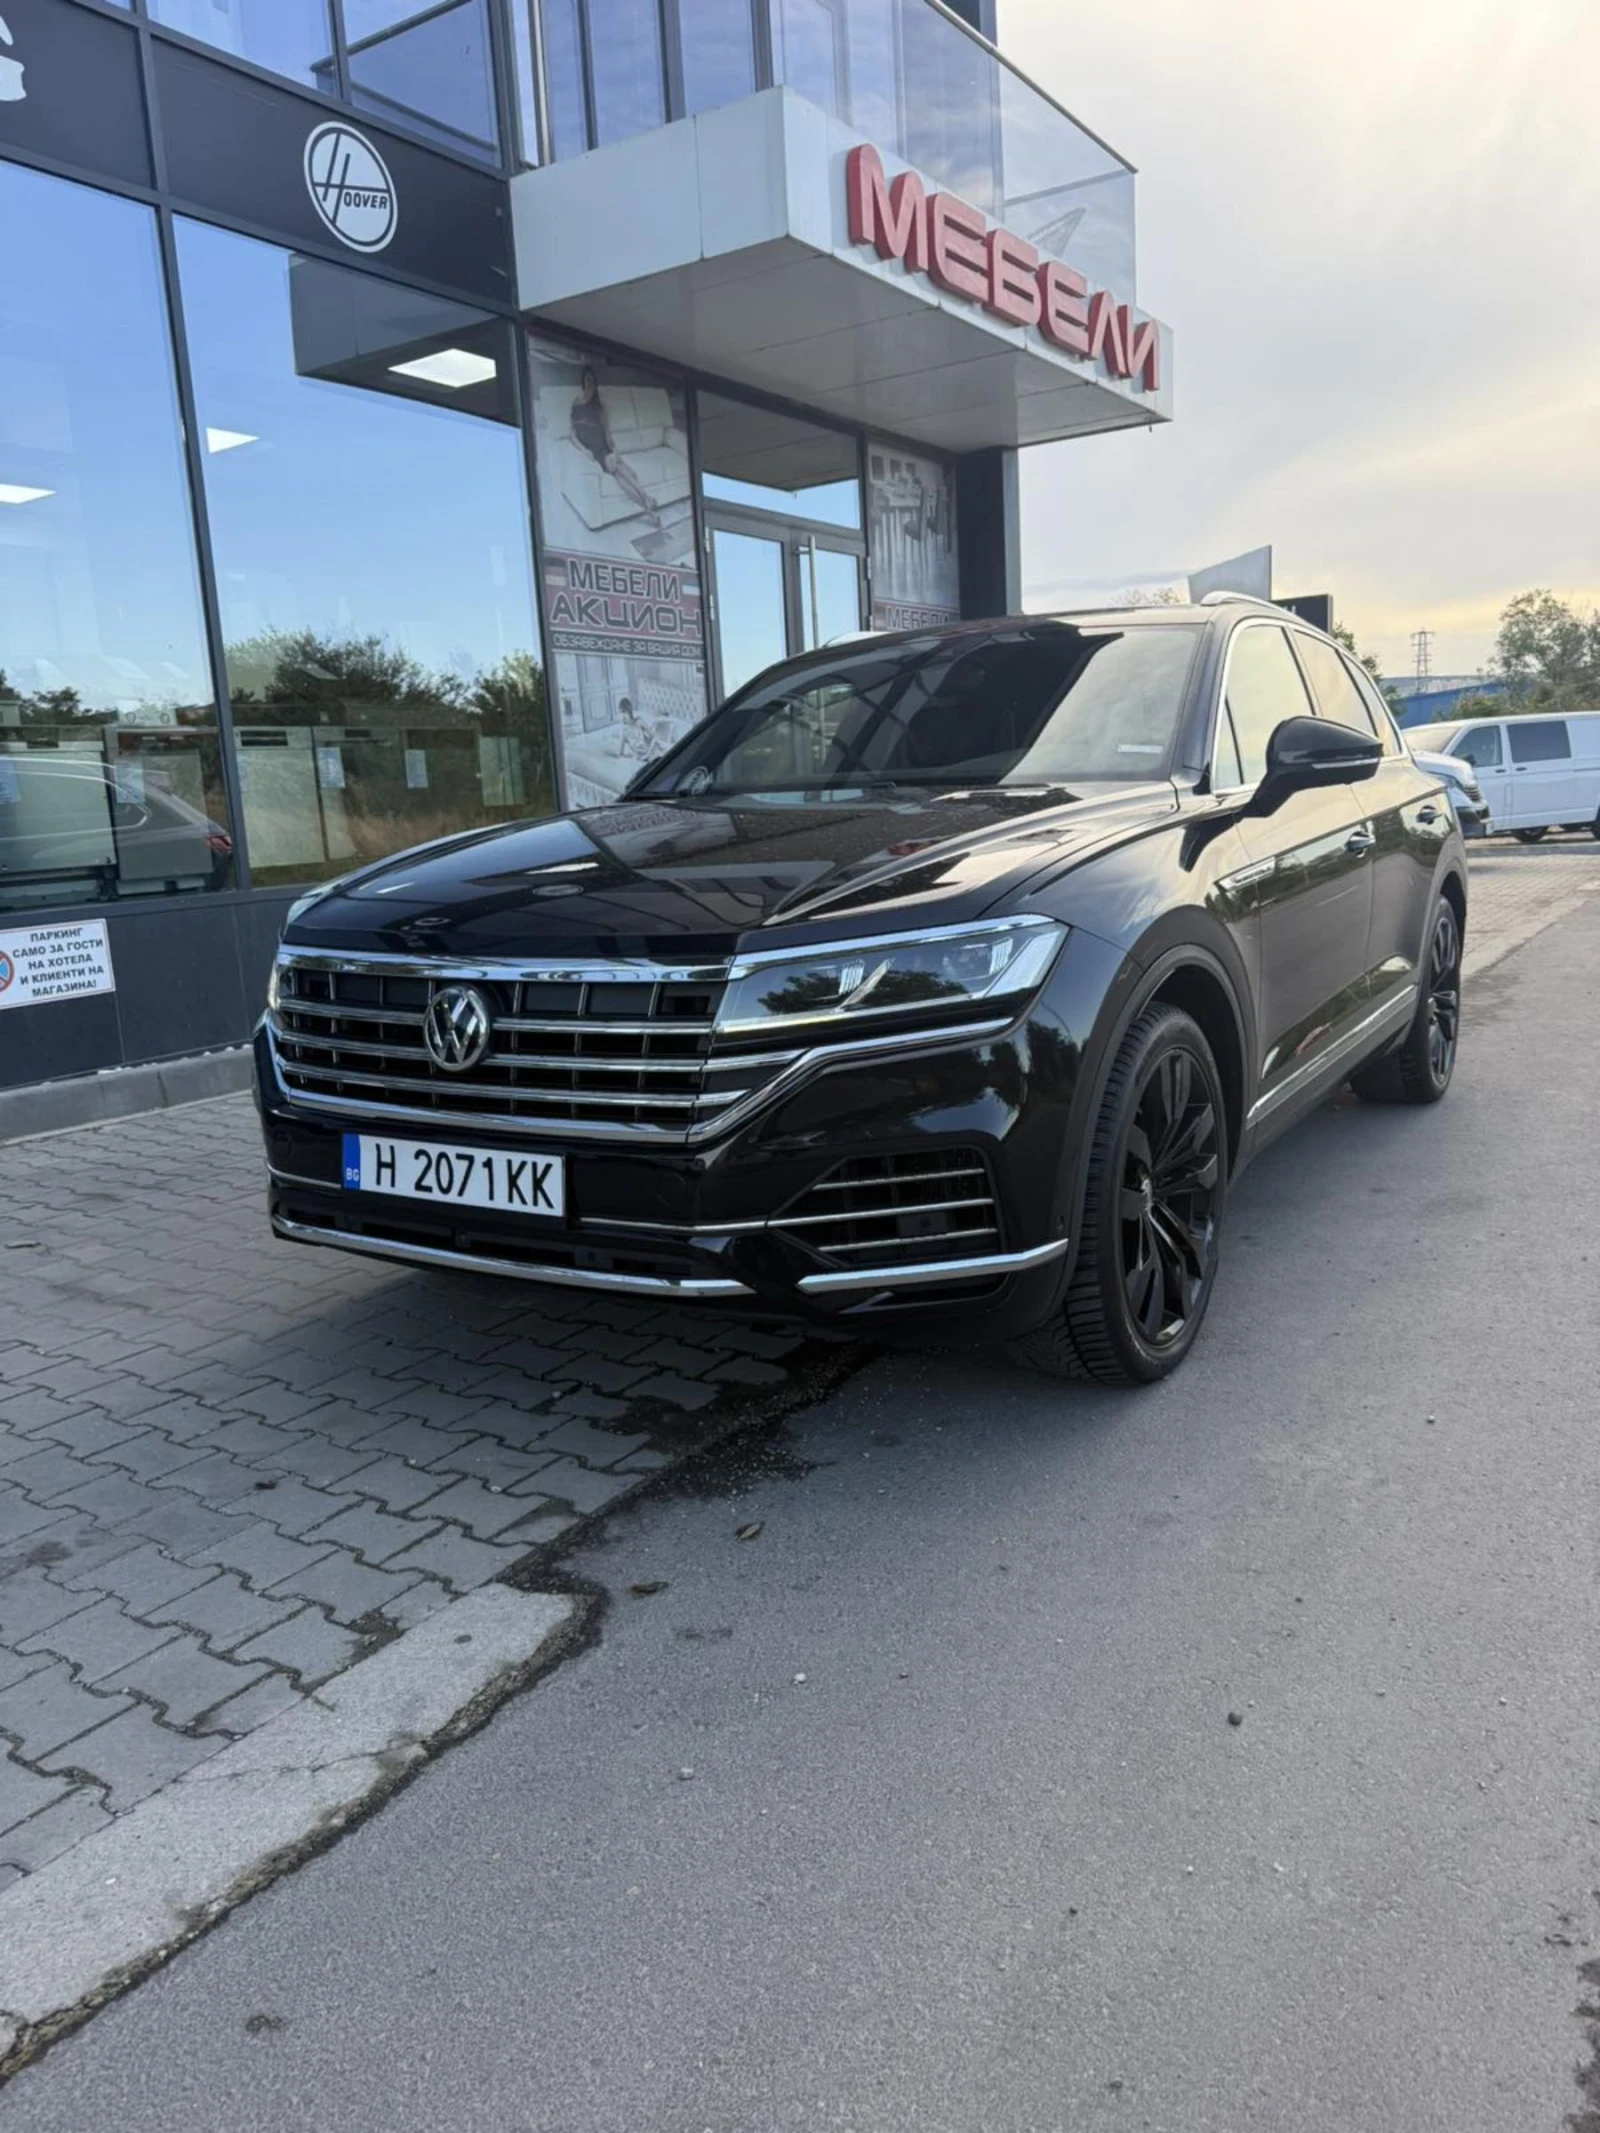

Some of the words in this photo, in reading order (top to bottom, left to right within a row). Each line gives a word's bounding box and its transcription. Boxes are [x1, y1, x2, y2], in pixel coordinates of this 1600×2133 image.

[846, 143, 1159, 393] МЕБЕЛИ
[567, 558, 681, 604] МЕБЕЛИ
[549, 592, 701, 638] АКЦИОН
[30, 927, 83, 942] ПАРКИНГ
[12, 945, 46, 959] САМО
[49, 944, 65, 954] ЗА
[66, 939, 103, 952] ГОСТИ
[28, 961, 45, 970] НА
[48, 953, 93, 968] ХОТЕЛА
[20, 976, 29, 985] И
[31, 967, 86, 984] КЛИЕНТИ
[88, 965, 104, 975] НА
[32, 979, 97, 997] МАГАЗИНА!
[345, 1166, 360, 1182] BG
